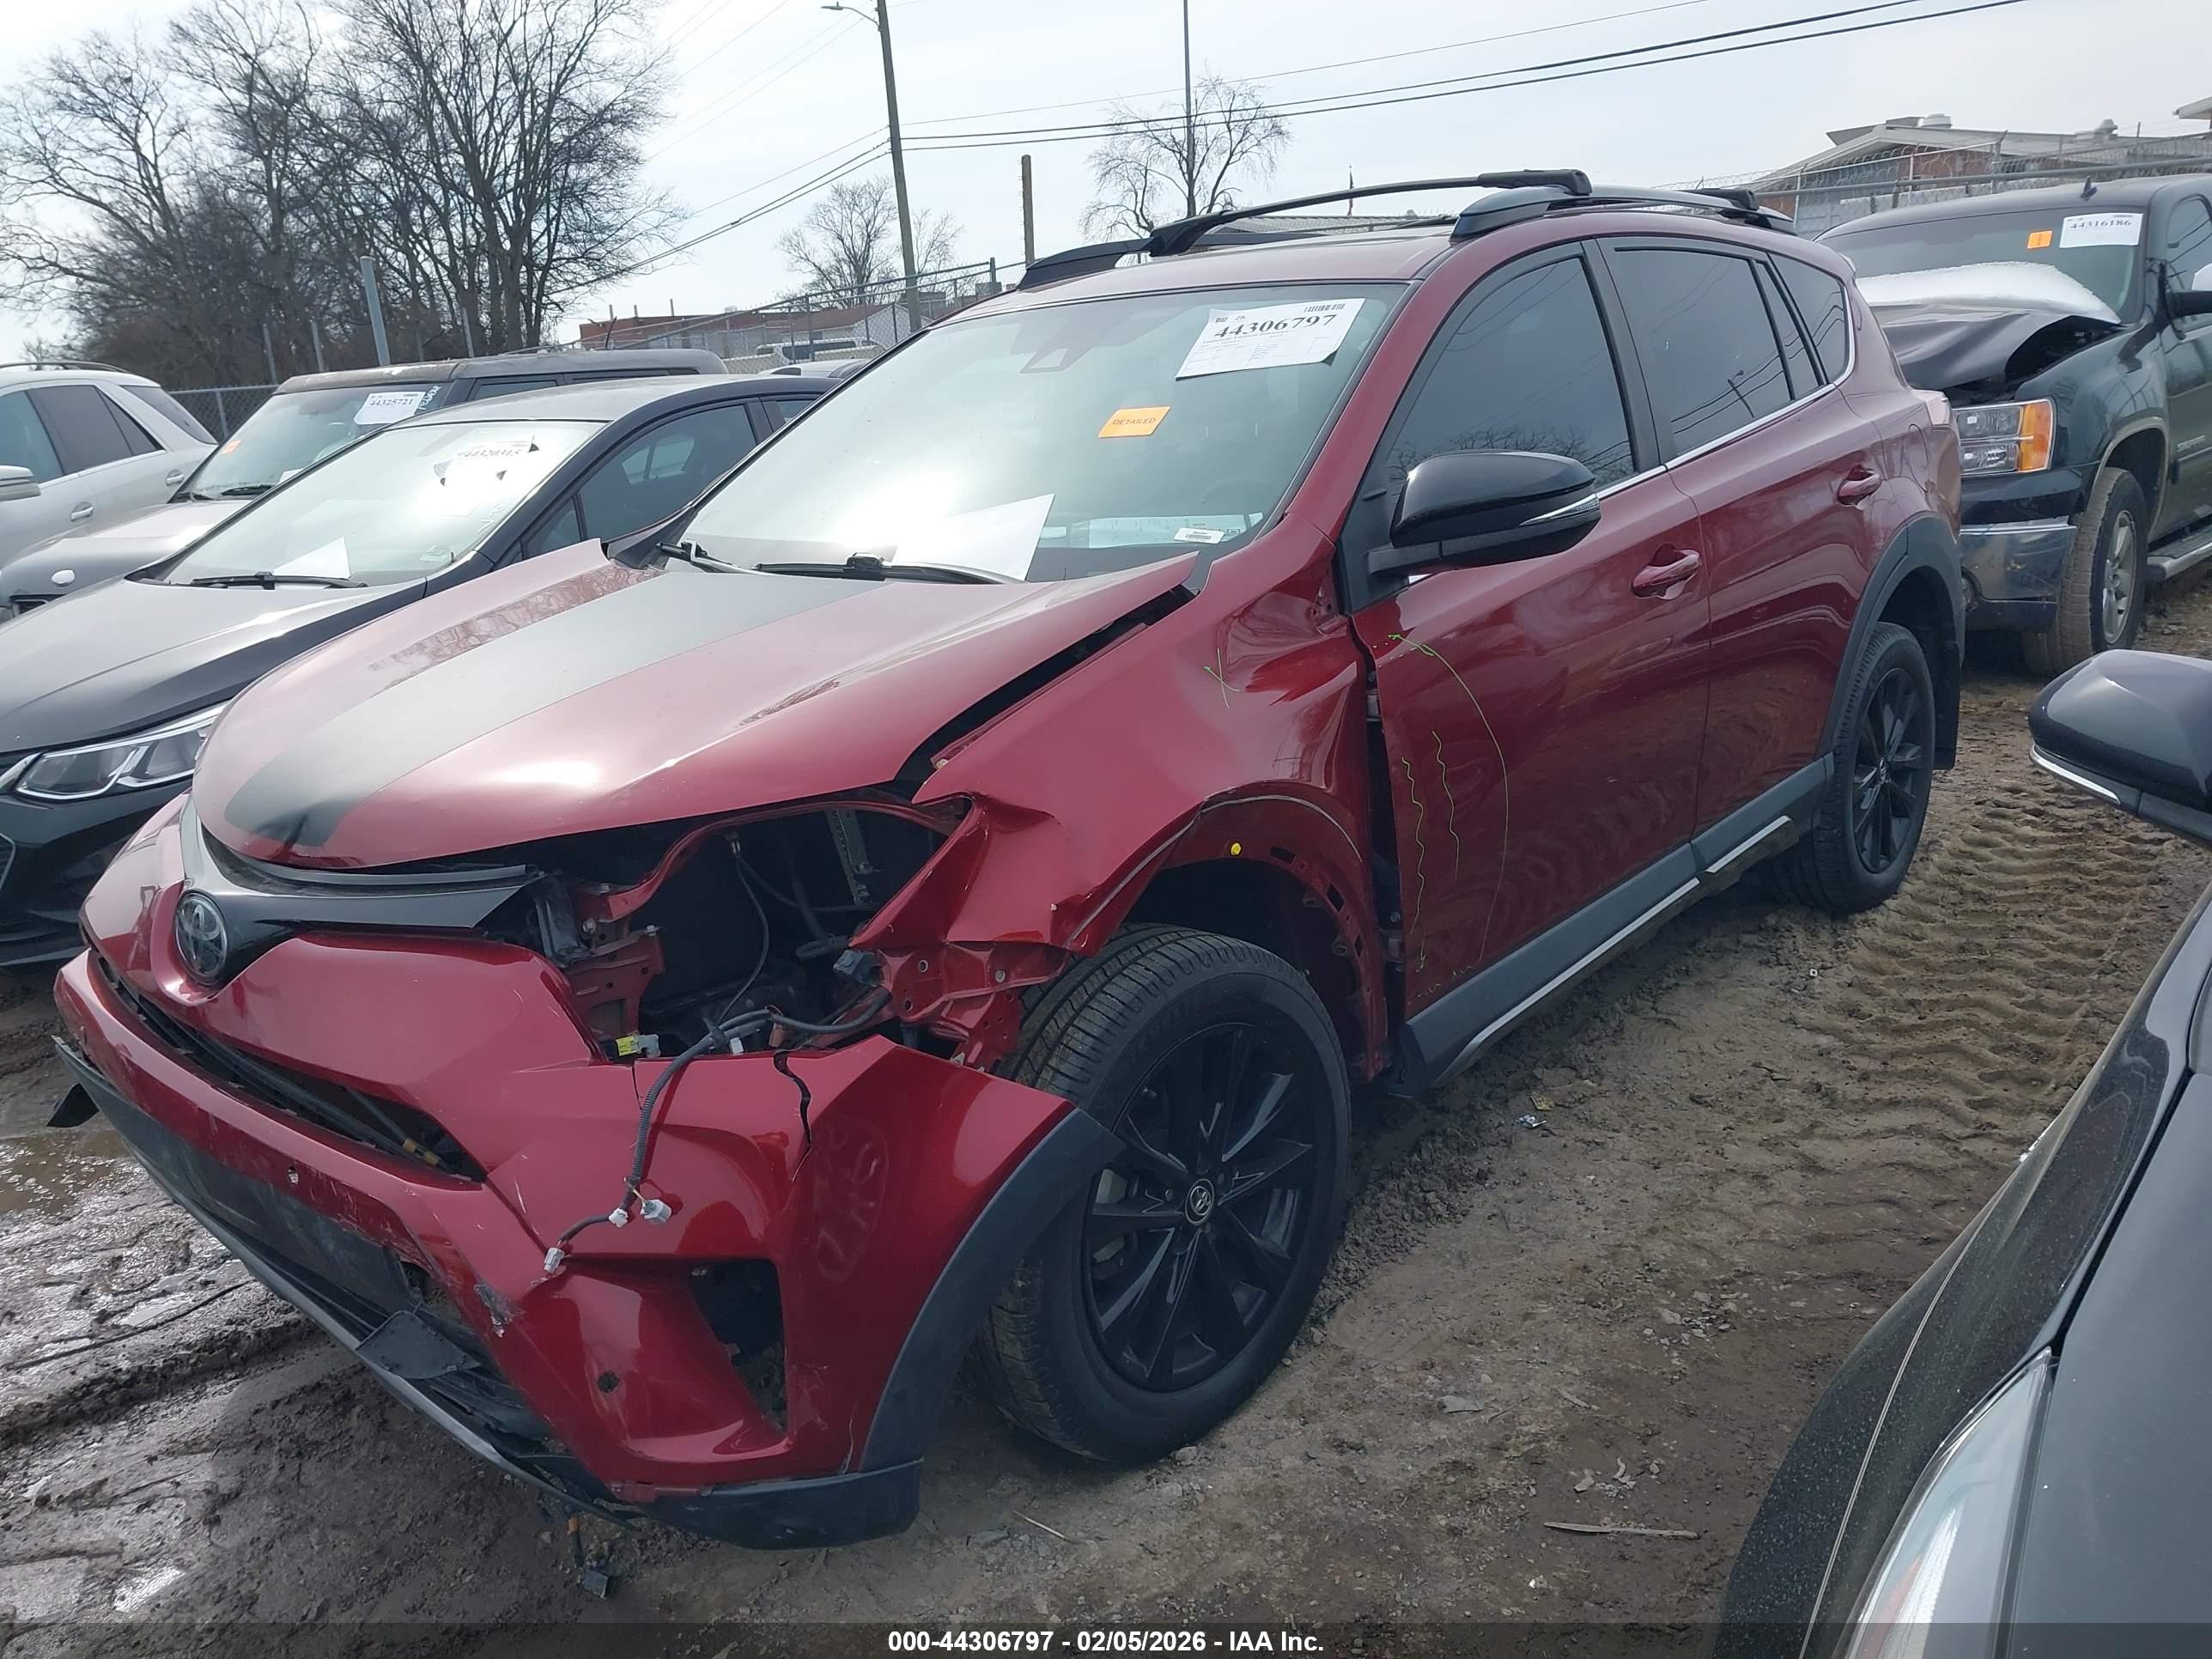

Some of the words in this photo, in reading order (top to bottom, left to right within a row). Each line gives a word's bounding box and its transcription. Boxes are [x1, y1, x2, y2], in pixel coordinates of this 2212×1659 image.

[2070, 220, 2132, 229] 44316186
[1213, 313, 1338, 338] 44306797
[369, 398, 414, 406] 44325721
[1111, 417, 1158, 426] DETAILED
